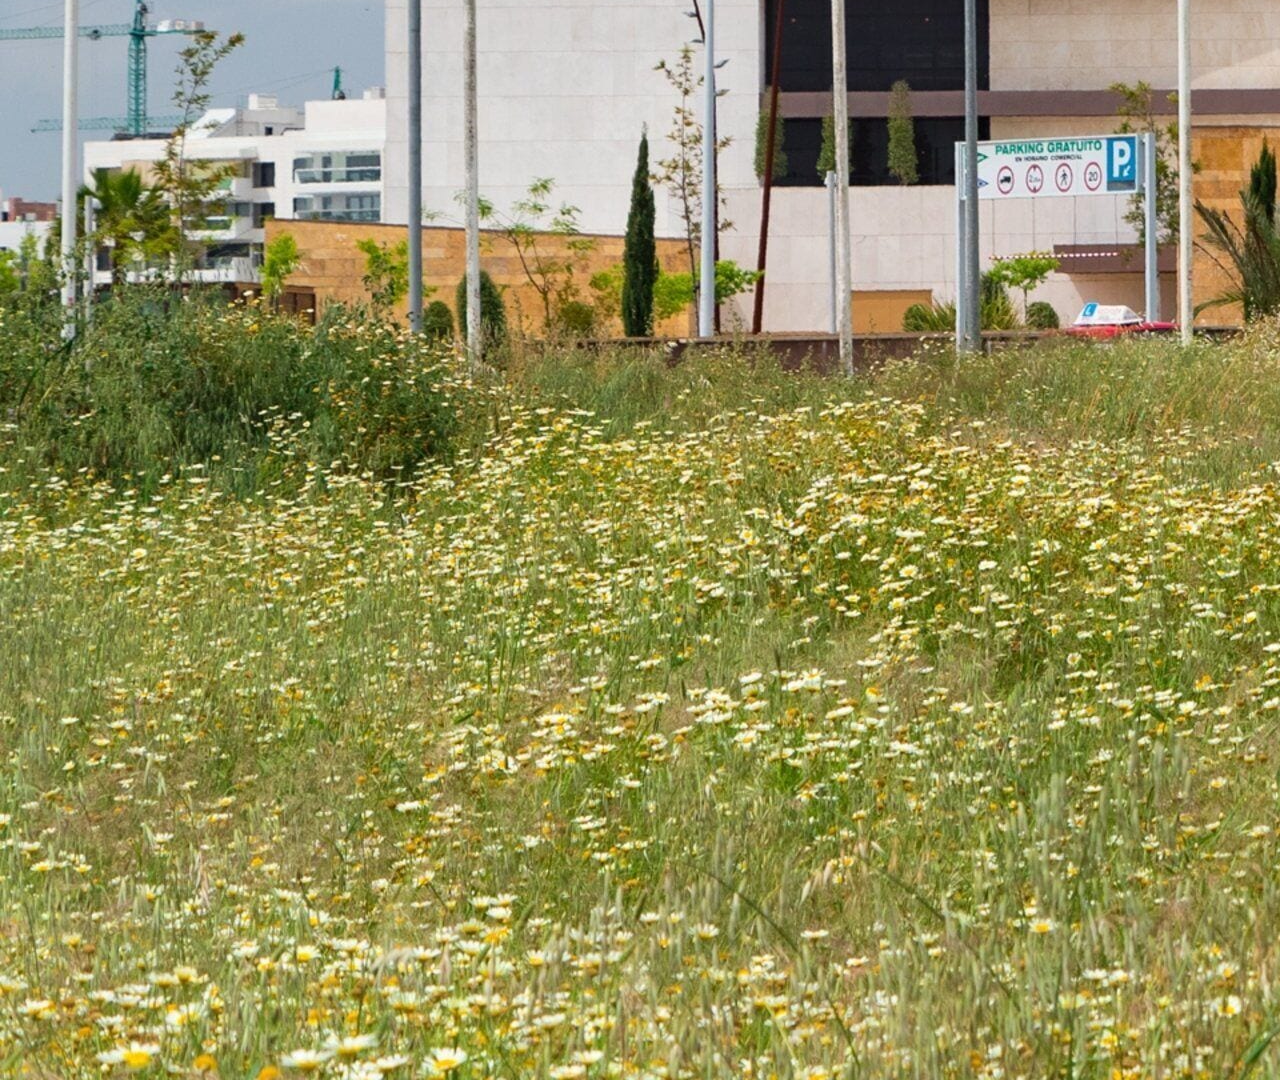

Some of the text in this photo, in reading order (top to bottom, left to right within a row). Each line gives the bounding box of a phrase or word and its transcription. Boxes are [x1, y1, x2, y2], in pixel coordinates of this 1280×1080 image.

[995, 139, 1103, 155] PARKING GRATUITO
[1112, 140, 1131, 178] P
[1088, 171, 1098, 182] 20
